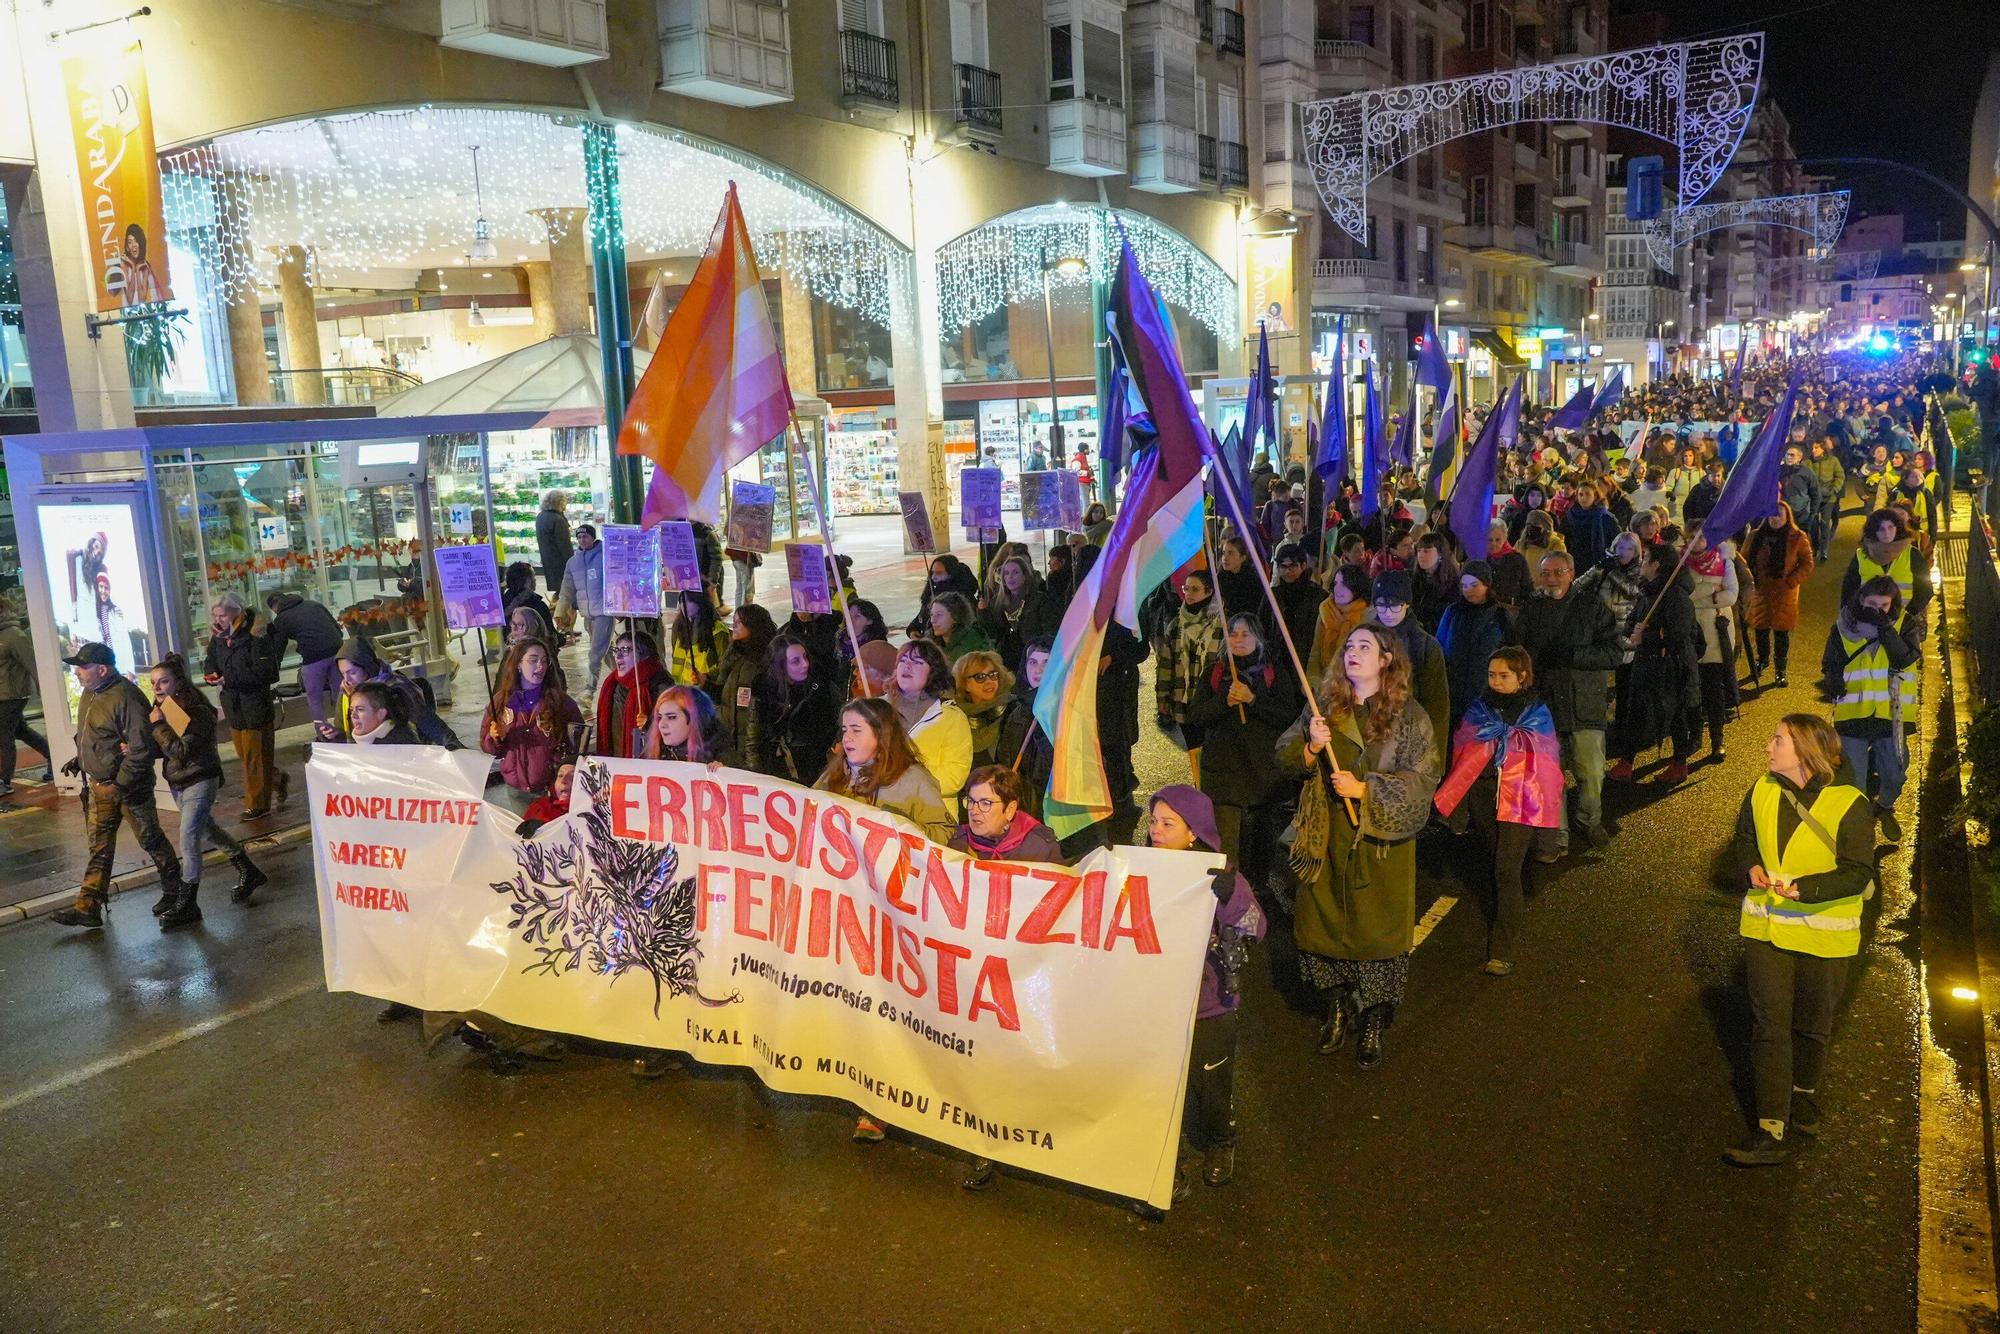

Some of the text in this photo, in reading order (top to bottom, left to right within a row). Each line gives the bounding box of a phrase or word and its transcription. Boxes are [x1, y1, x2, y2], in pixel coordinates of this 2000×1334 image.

[325, 793, 482, 826] KONPLIZITATE
[328, 841, 407, 870] SAREEN
[610, 774, 1162, 955] ERRESISTENTZIA
[696, 863, 1021, 1032] FEMINISTA
[780, 970, 872, 1013] hipocresía
[878, 1000, 897, 1022] es
[901, 1010, 975, 1058] violencia!
[816, 1057, 929, 1114] MUGIMENDU
[939, 1101, 1054, 1151] FEMINISTA
